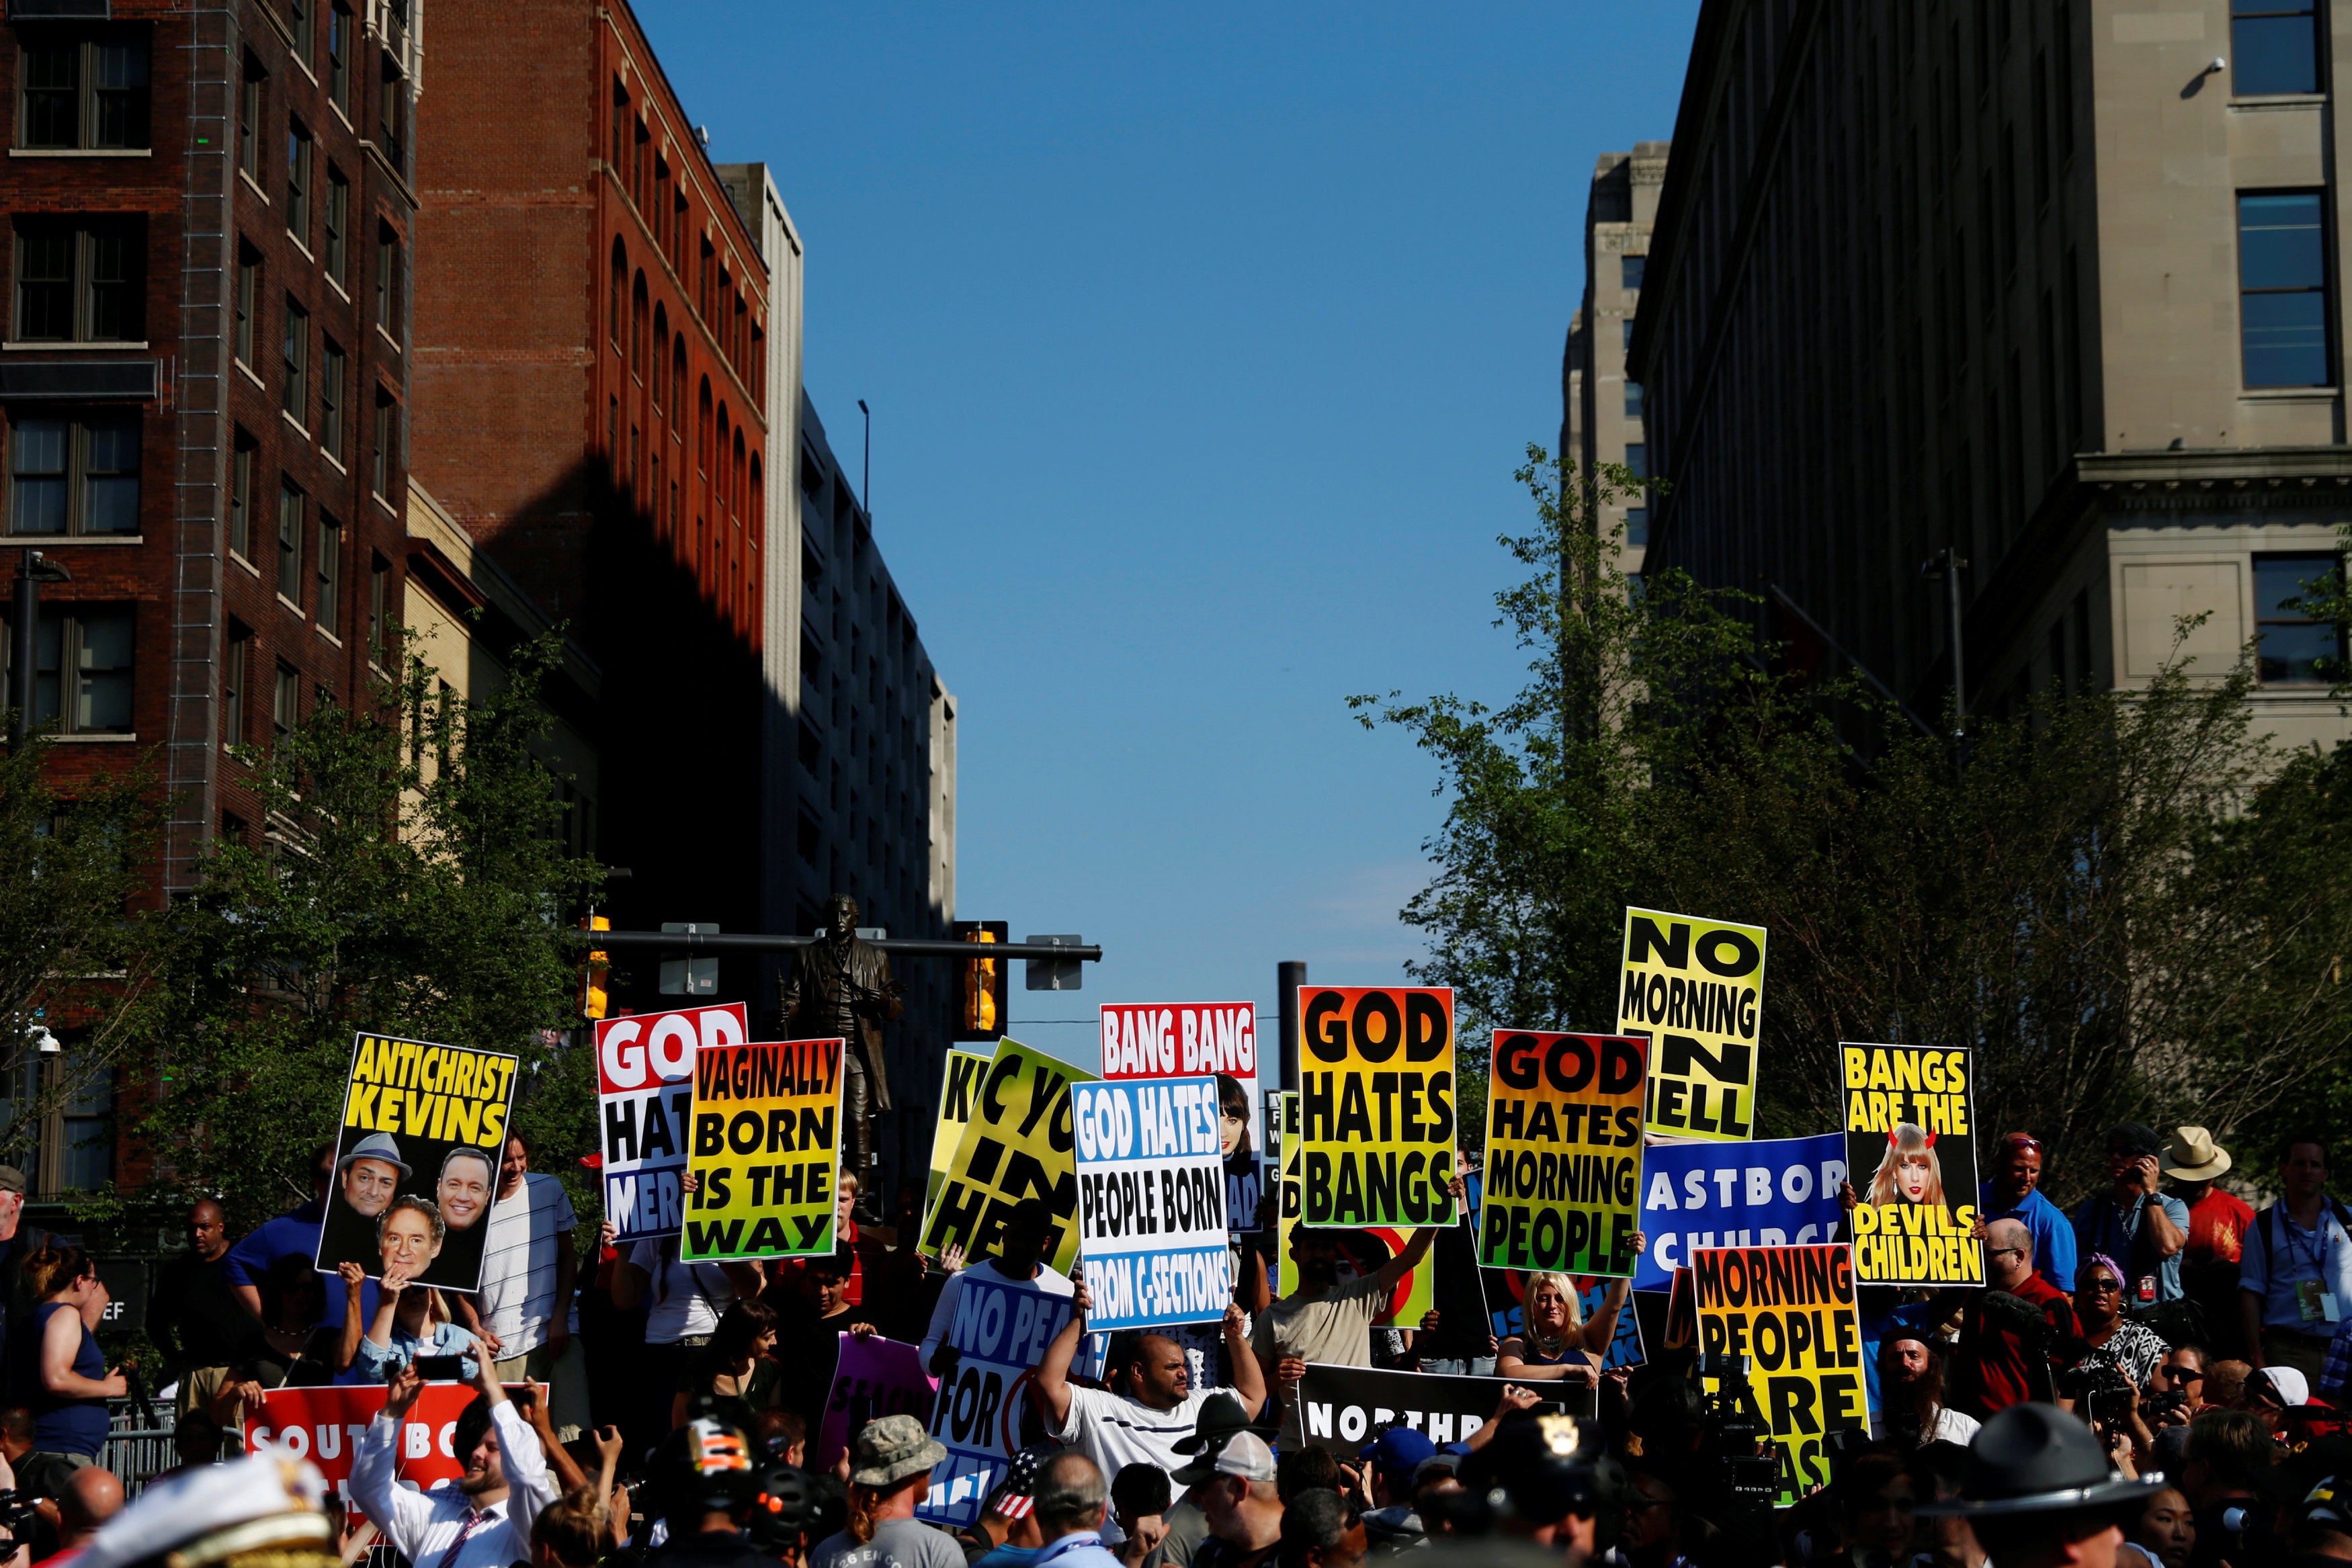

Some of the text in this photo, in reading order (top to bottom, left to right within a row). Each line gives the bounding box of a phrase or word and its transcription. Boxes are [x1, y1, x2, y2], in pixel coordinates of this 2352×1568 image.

[1628, 916, 1760, 977] NO
[1305, 990, 1447, 1063] GOD
[1622, 970, 1756, 1039] MORNING
[353, 1038, 515, 1101] ANTICHRIST
[698, 1043, 840, 1101] VAGINALLY
[1103, 1008, 1254, 1074] BANG BANG
[1496, 1035, 1643, 1095] GOD
[1844, 1048, 1966, 1094] BANGS
[345, 1083, 507, 1147] KEVINS
[694, 1106, 834, 1157] BORN
[1077, 1088, 1134, 1160] GOD
[1137, 1082, 1217, 1156] HATES
[1302, 1071, 1453, 1143] HATES
[1493, 1098, 1640, 1147] HATES
[1848, 1091, 1968, 1135] ARE THE
[692, 1162, 831, 1210] IS THE
[1081, 1166, 1223, 1238] PEOPLE BORN
[1306, 1151, 1453, 1223] BANGS
[1488, 1149, 1634, 1207] MORNING
[687, 1214, 832, 1256] WAY
[1484, 1204, 1633, 1274] PEOPLE
[1853, 1203, 1976, 1237] DEVILS
[1085, 1258, 1134, 1321] FROM
[1695, 1246, 1854, 1309] MORNING
[1855, 1234, 1982, 1282] CHILDREN
[953, 1282, 1007, 1357] NO
[1701, 1309, 1859, 1371] PEOPLE
[933, 1364, 1003, 1448] FOR
